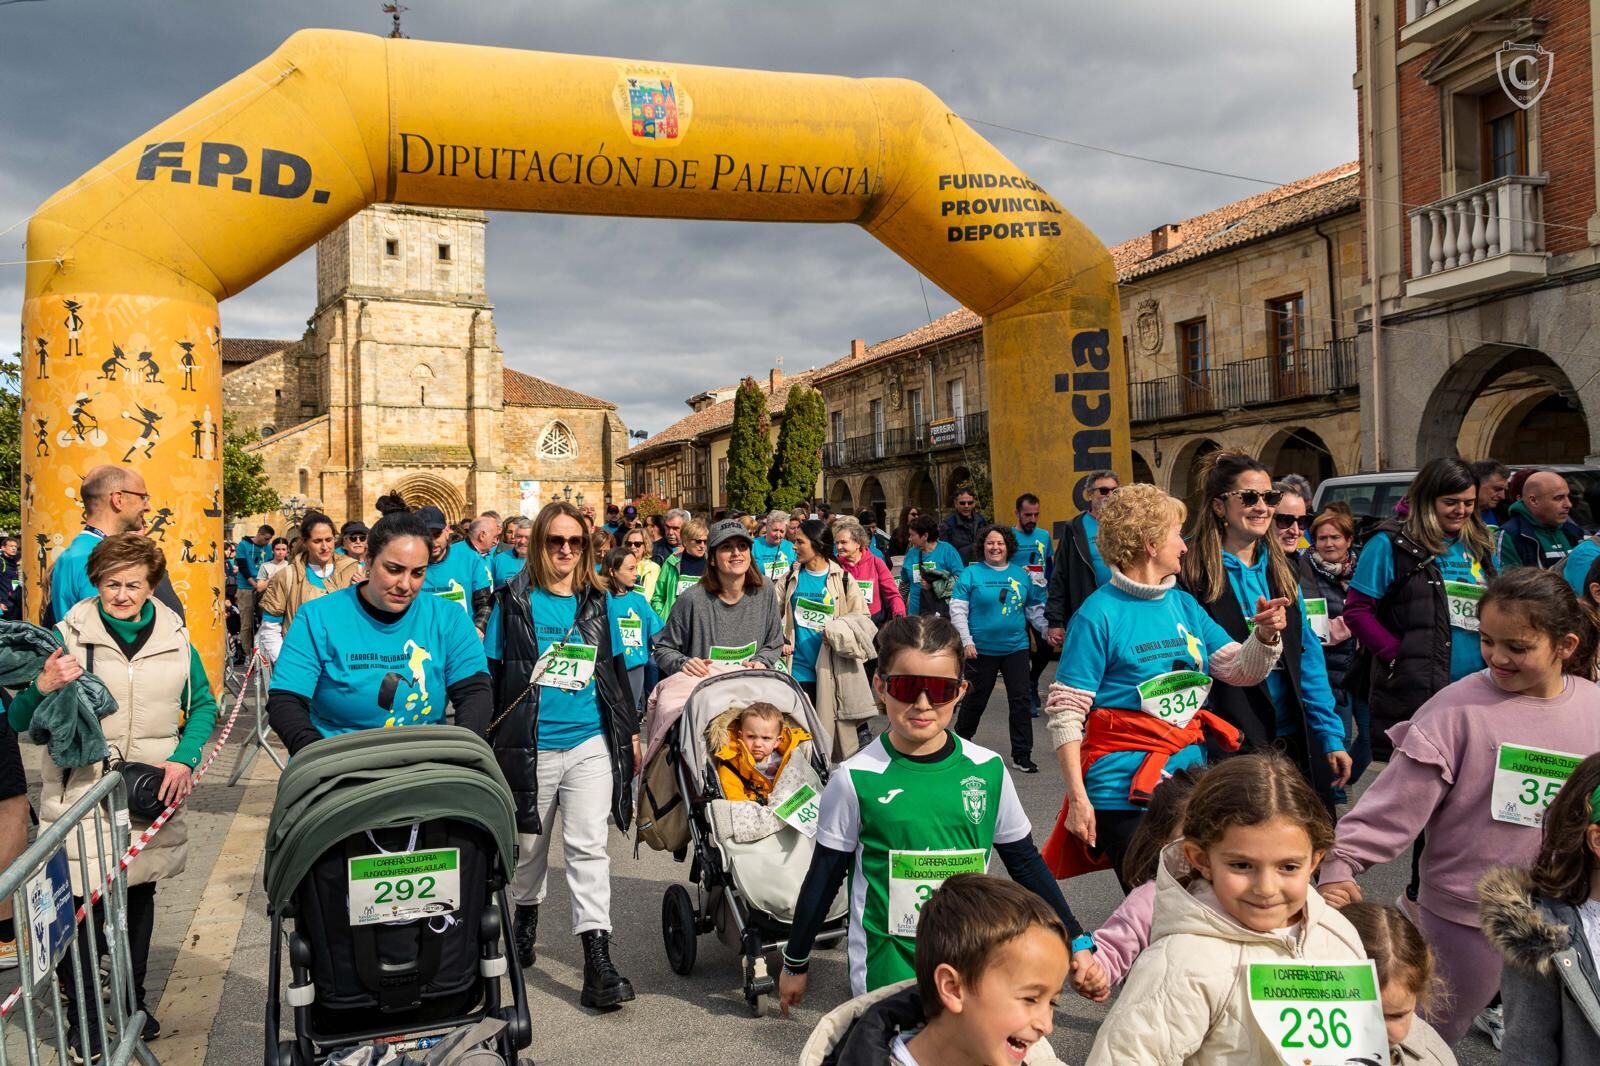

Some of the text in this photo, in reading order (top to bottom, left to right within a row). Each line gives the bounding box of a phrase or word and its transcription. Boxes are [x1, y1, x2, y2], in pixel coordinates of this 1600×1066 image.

[136, 141, 331, 204] F.P.D.
[399, 132, 871, 196] DIPUTACIÓN DE PALENCIA
[941, 198, 1062, 217] PROVINCIAL
[947, 221, 1062, 243] DEPORTES
[802, 610, 825, 624] 322
[545, 658, 579, 678] 221
[1159, 689, 1199, 717] 334
[1519, 778, 1562, 809] 35
[797, 802, 819, 823] 481
[917, 858, 947, 867] CARRERA
[374, 876, 436, 904] 292
[1279, 969, 1309, 981] CARRERA
[1309, 968, 1345, 982] SOLIDARIA
[1301, 987, 1331, 999] PERSONAS
[1331, 988, 1361, 999] AGUILAR
[1279, 1007, 1352, 1049] 236
